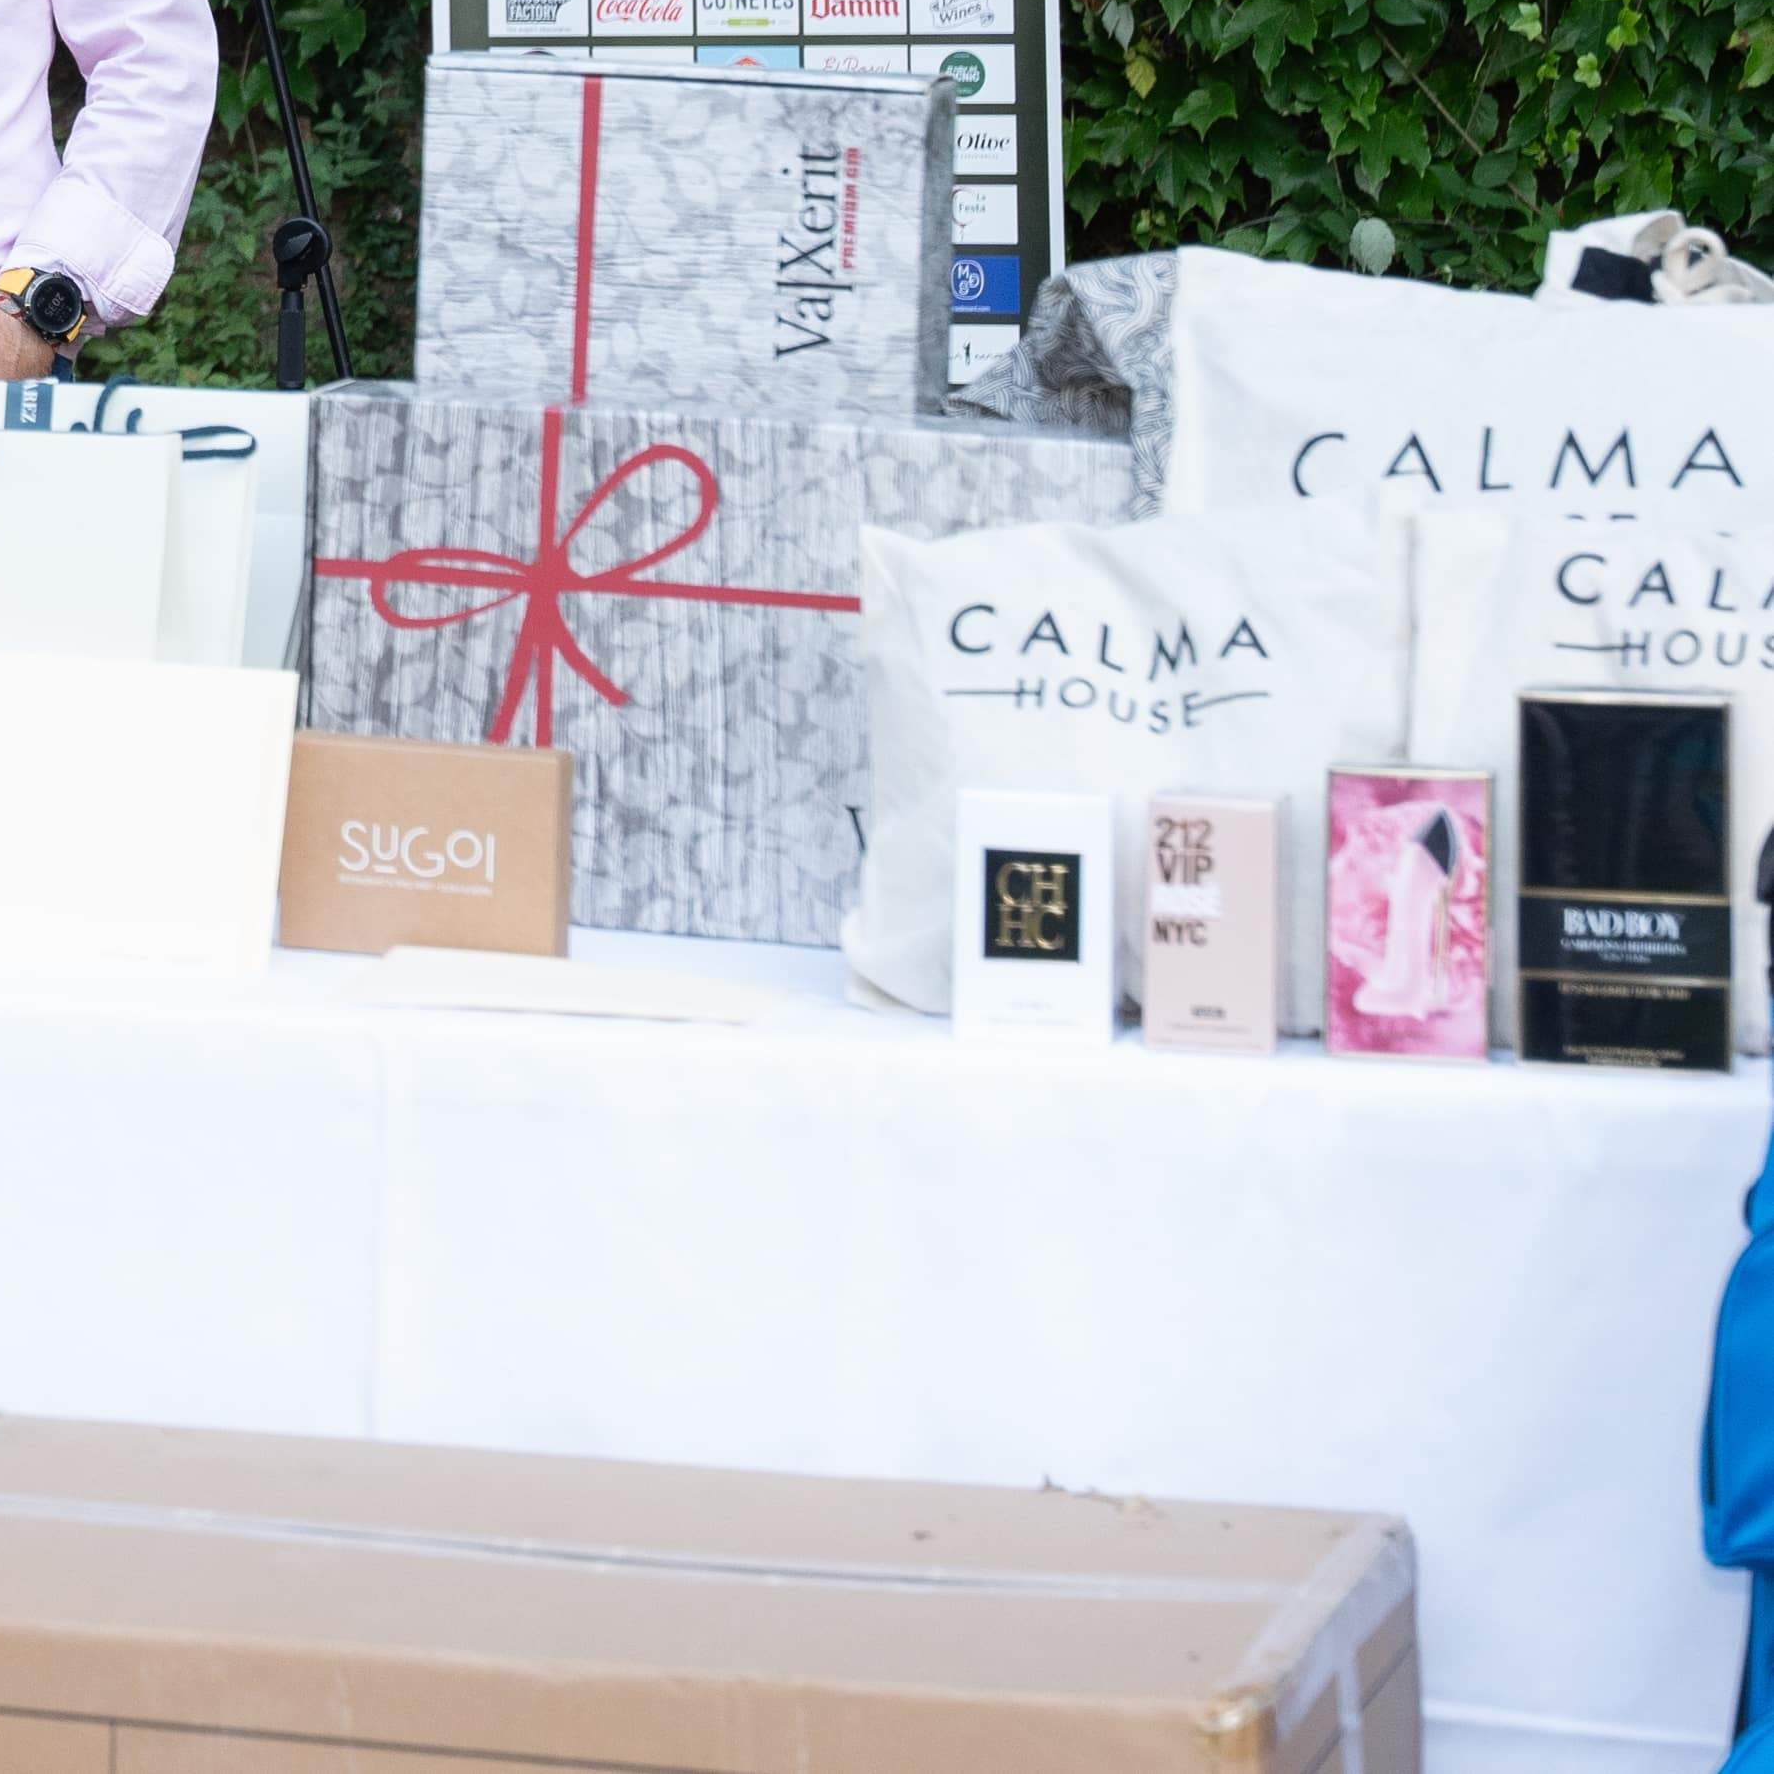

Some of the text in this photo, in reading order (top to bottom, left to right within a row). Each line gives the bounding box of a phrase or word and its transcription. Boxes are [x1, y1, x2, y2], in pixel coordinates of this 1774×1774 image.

[509, 4, 560, 23] FACTORY
[939, 1, 982, 25] Wines
[957, 132, 1010, 152] Olive
[1292, 424, 1743, 500] CALMA
[1555, 552, 1774, 613] CAL
[949, 603, 1272, 685] CALMA
[1013, 676, 1206, 735] HOUSE
[1155, 816, 1214, 852] 212
[1156, 852, 1214, 886] VIP
[1153, 919, 1208, 947] NYC
